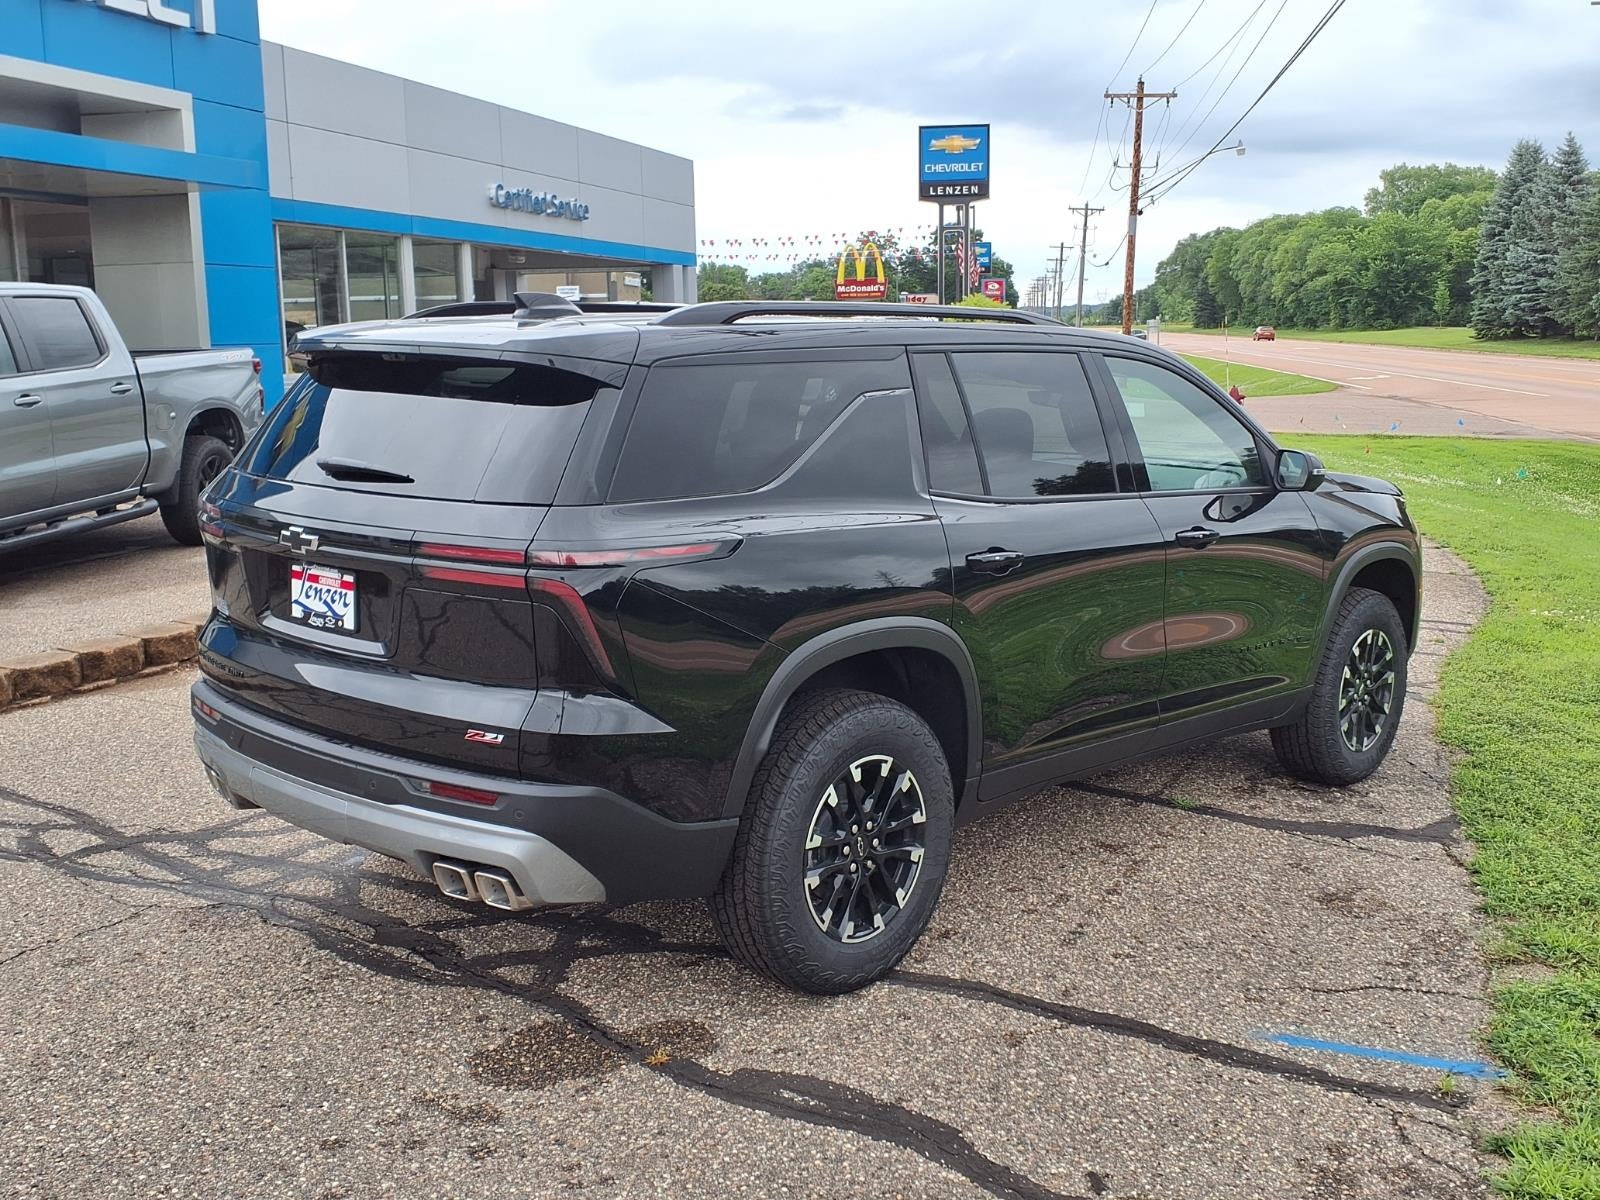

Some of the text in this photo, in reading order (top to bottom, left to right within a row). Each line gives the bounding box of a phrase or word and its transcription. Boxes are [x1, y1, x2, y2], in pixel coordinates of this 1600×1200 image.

[924, 162, 983, 173] CHEVROLET
[929, 185, 979, 195] LENZEN
[489, 183, 589, 221] Certified Service
[837, 285, 885, 293] McDonald's
